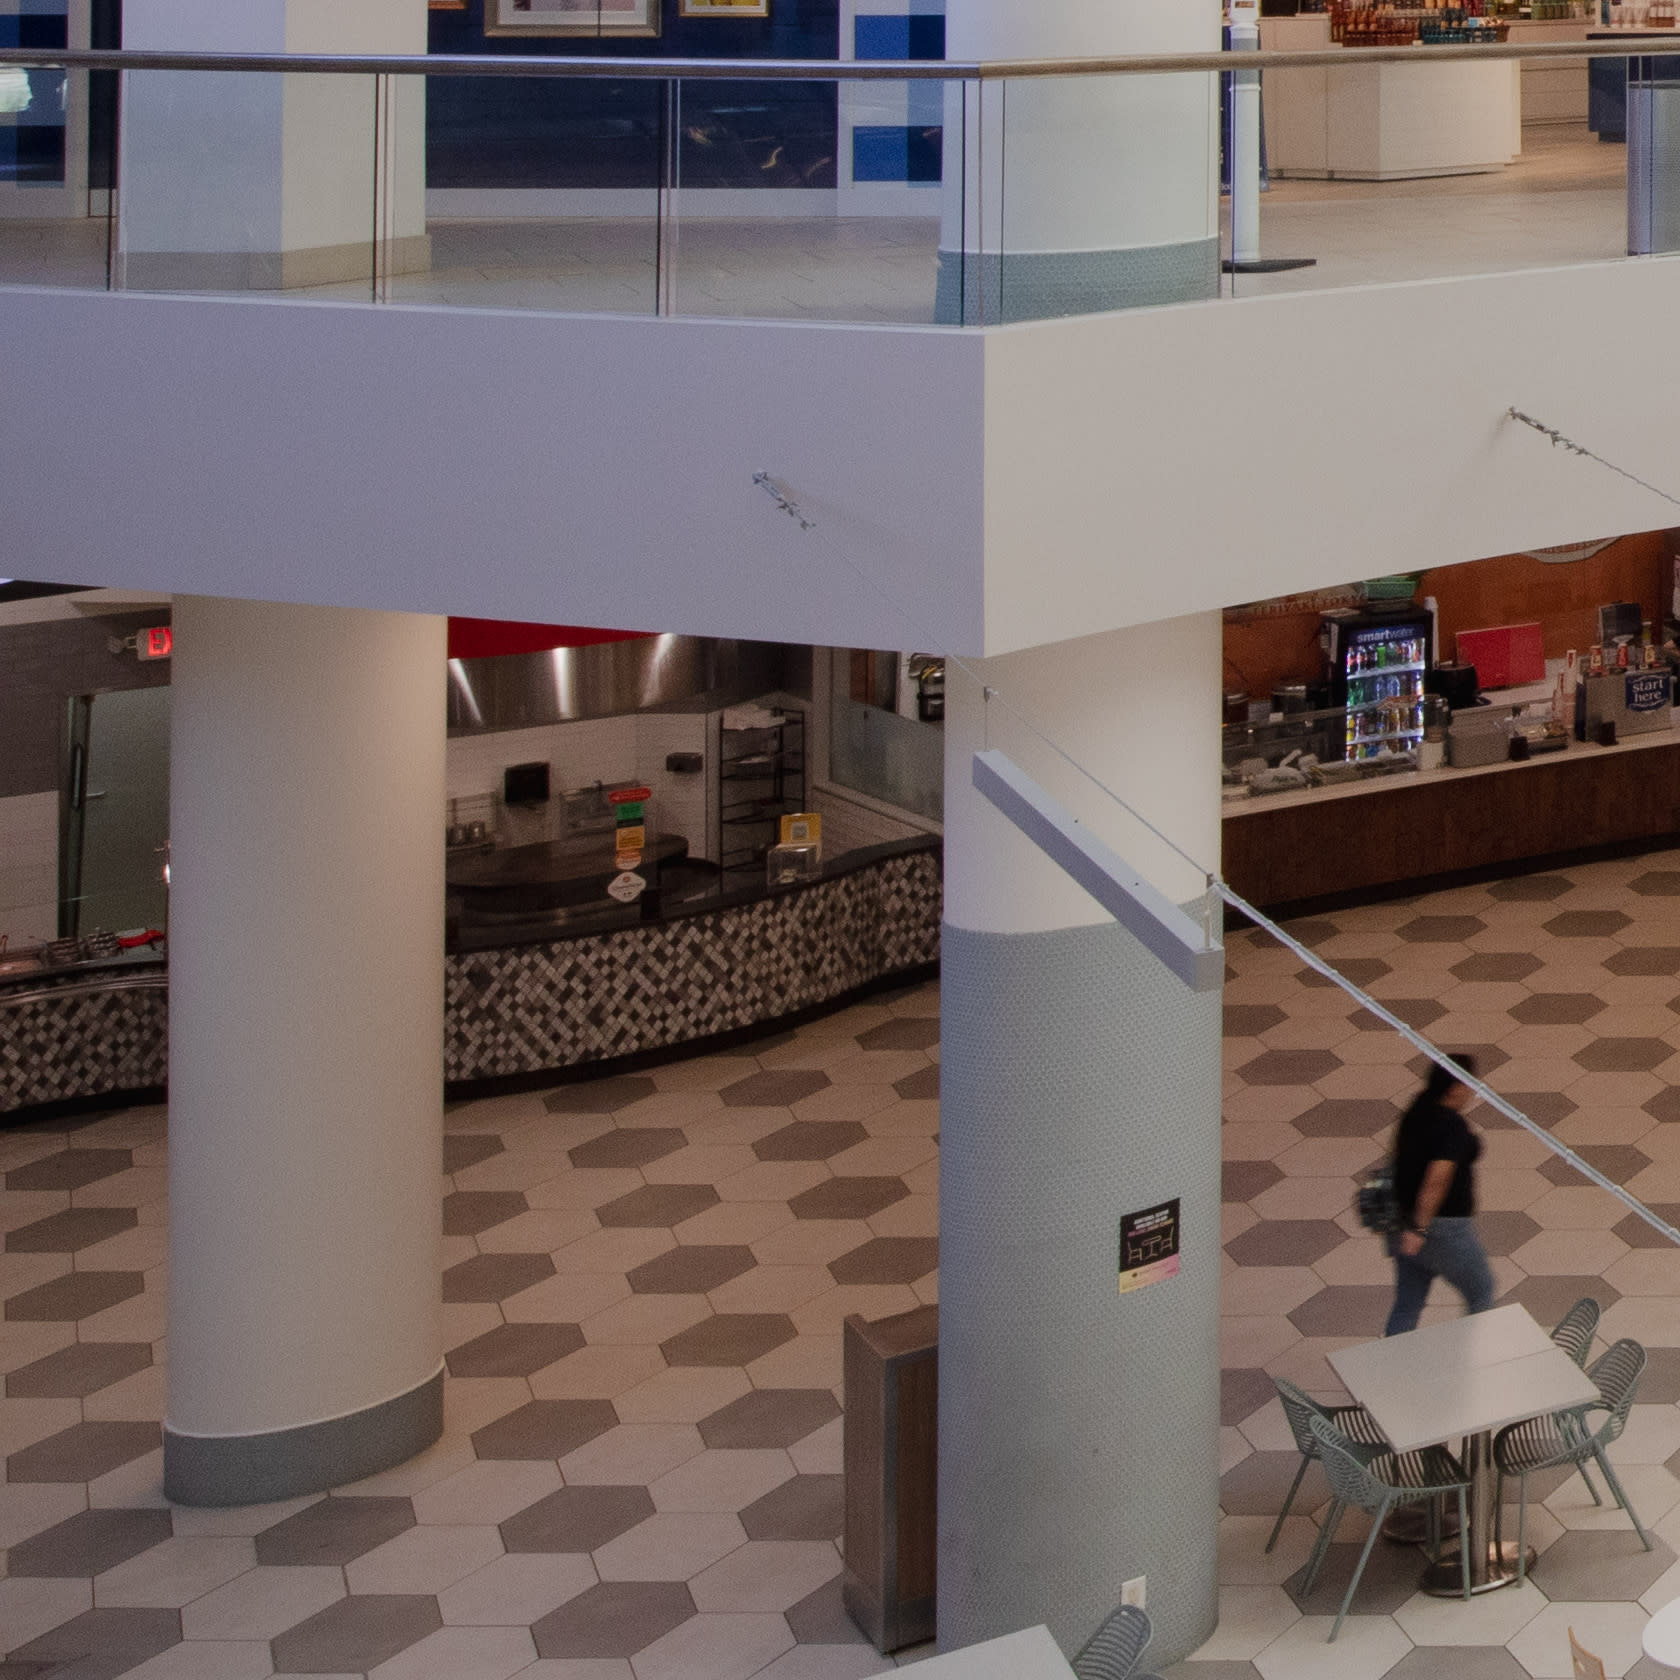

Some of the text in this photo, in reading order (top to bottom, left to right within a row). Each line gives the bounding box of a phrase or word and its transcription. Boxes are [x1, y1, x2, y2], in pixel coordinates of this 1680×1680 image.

[1356, 627, 1415, 643] smartwater
[1631, 679, 1664, 693] start
[1633, 691, 1662, 703] here
